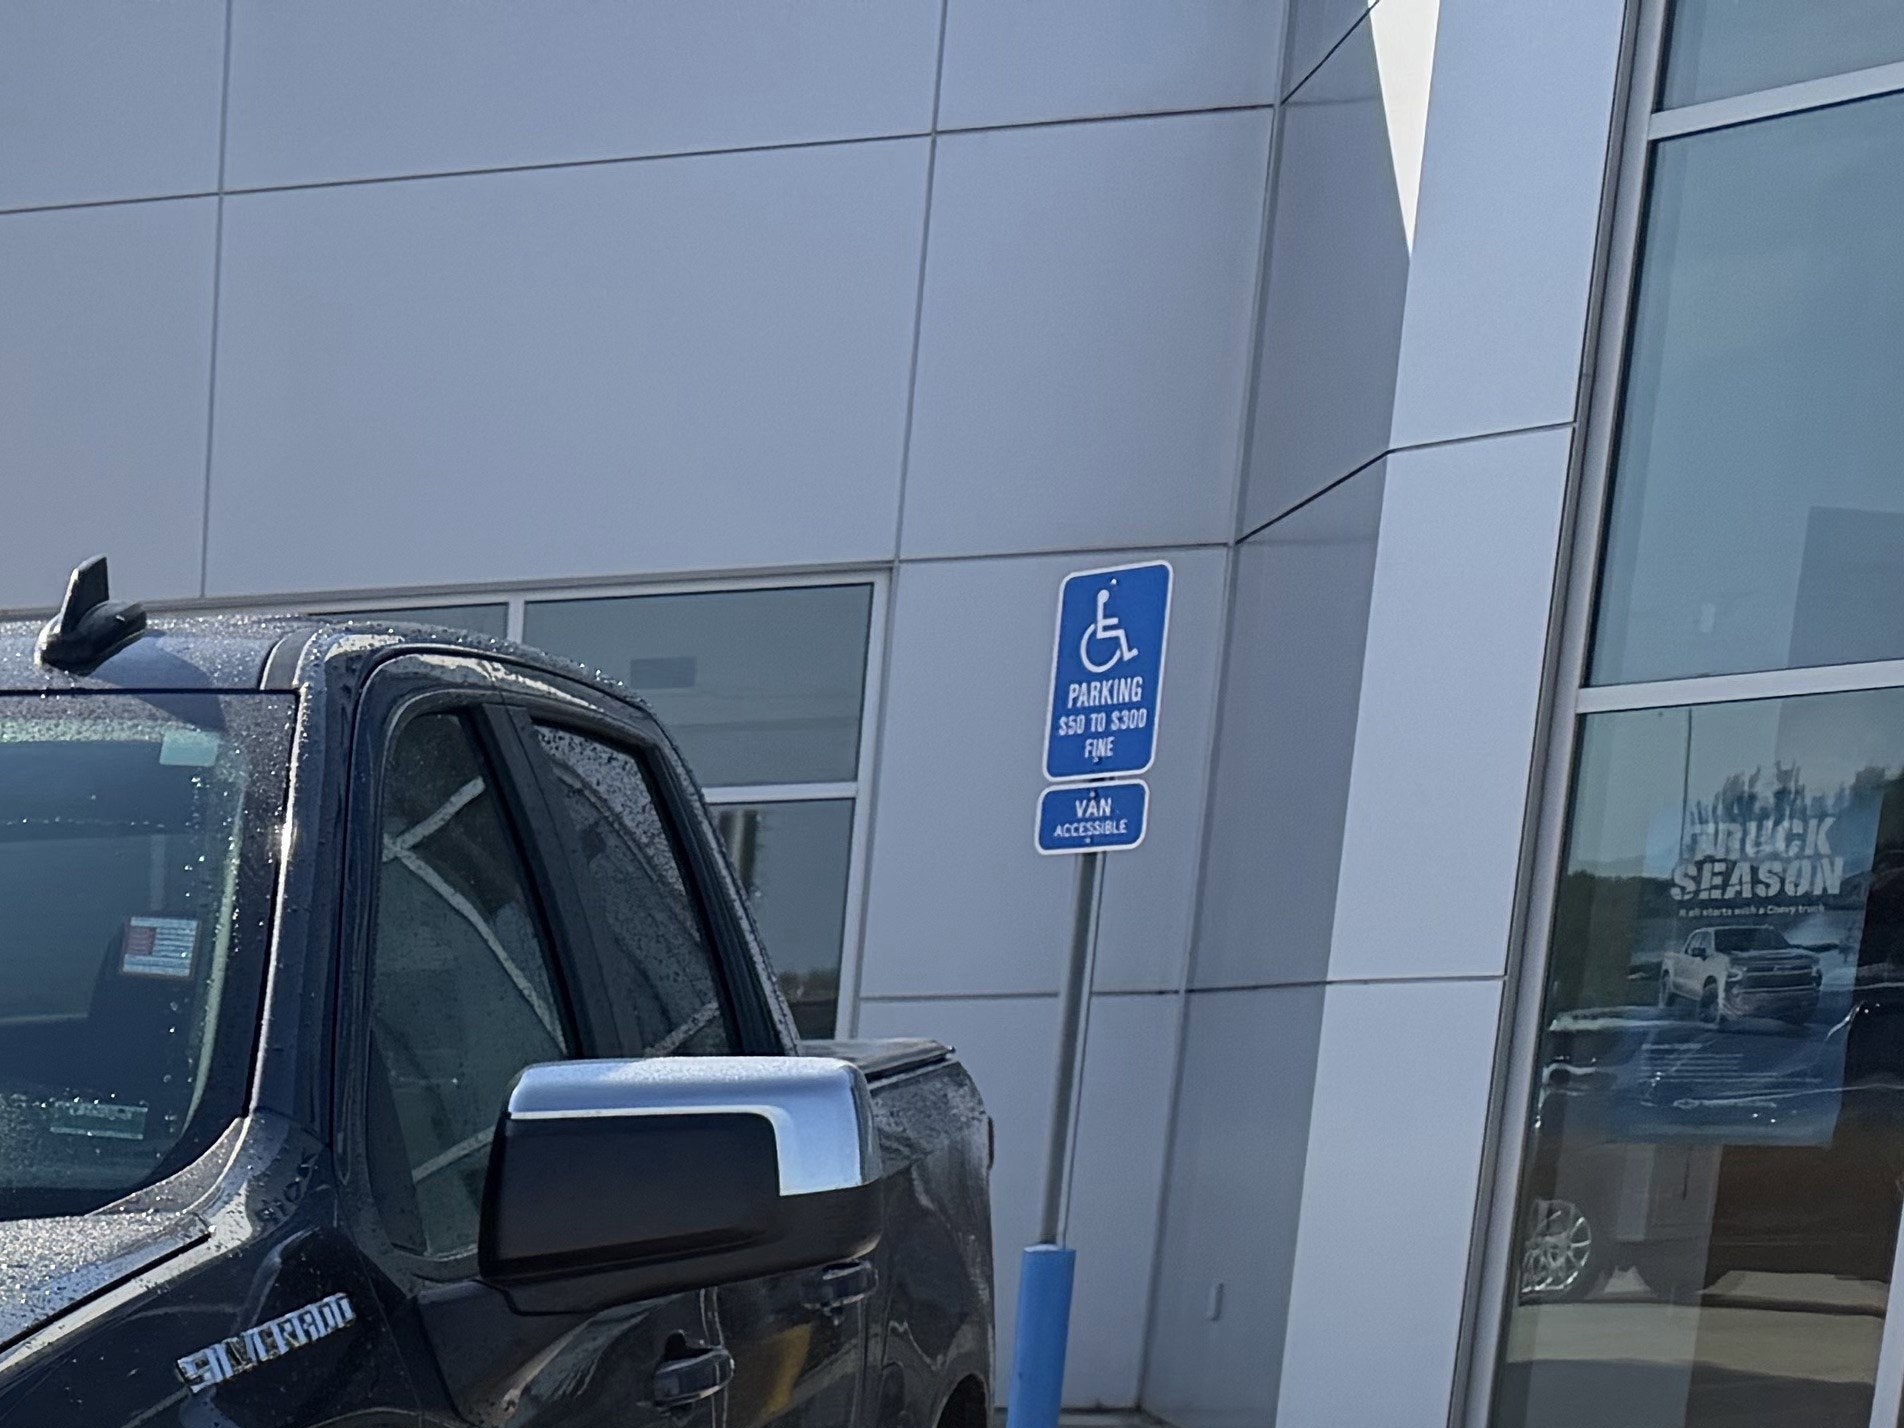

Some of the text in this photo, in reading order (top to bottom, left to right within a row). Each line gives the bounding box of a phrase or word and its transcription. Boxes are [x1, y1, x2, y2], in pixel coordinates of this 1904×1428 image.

[1067, 676, 1143, 709] PARKING
[1059, 708, 1148, 737] $50 TO $300
[1084, 736, 1115, 758] FINE
[1075, 797, 1112, 818] VAN
[1053, 819, 1128, 838] ACCESSIBLE
[1691, 817, 1836, 861] TRUCK
[1670, 857, 1843, 900] SEASON
[1766, 904, 1796, 916] Chevy
[175, 1292, 356, 1393] SILVERADO
